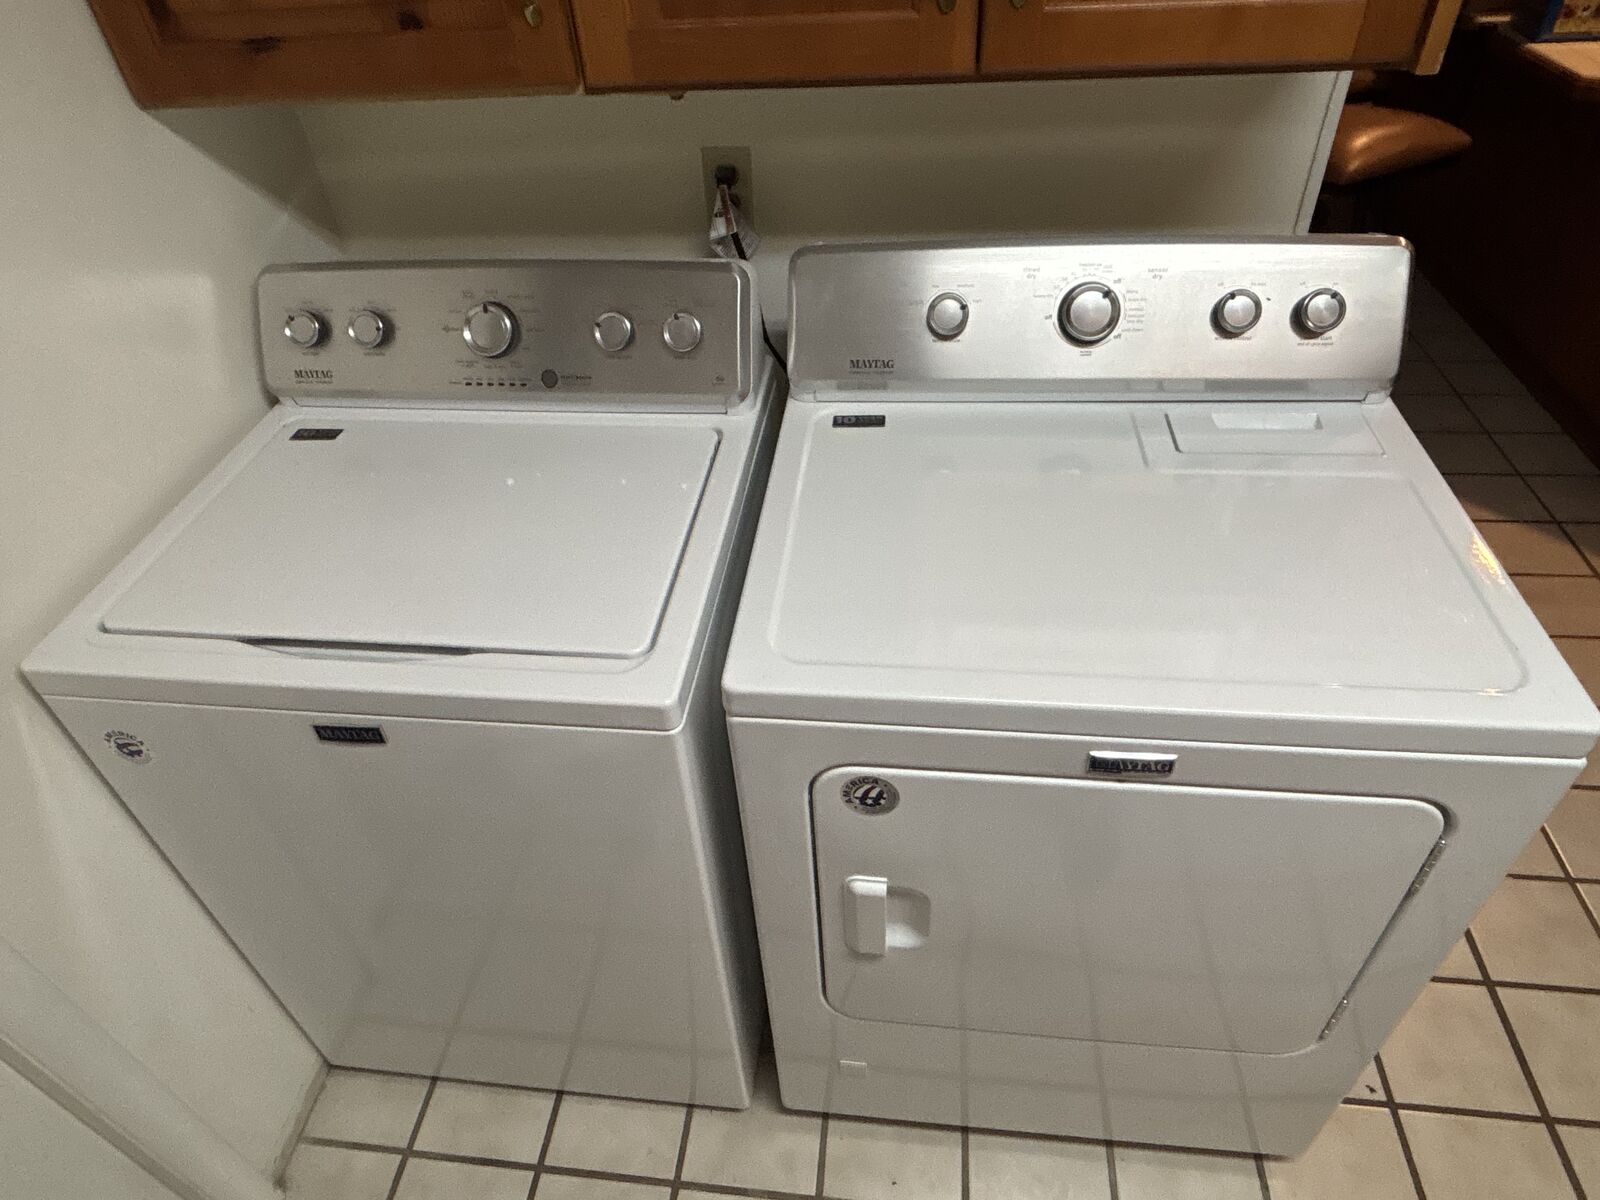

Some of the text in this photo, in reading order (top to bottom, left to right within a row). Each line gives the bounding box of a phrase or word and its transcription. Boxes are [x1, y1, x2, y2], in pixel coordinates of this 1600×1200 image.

[849, 360, 894, 369] MAYTAG
[294, 369, 333, 378] MAYTAG
[318, 727, 380, 740] MAYTAG
[842, 777, 880, 804] AMERICA
